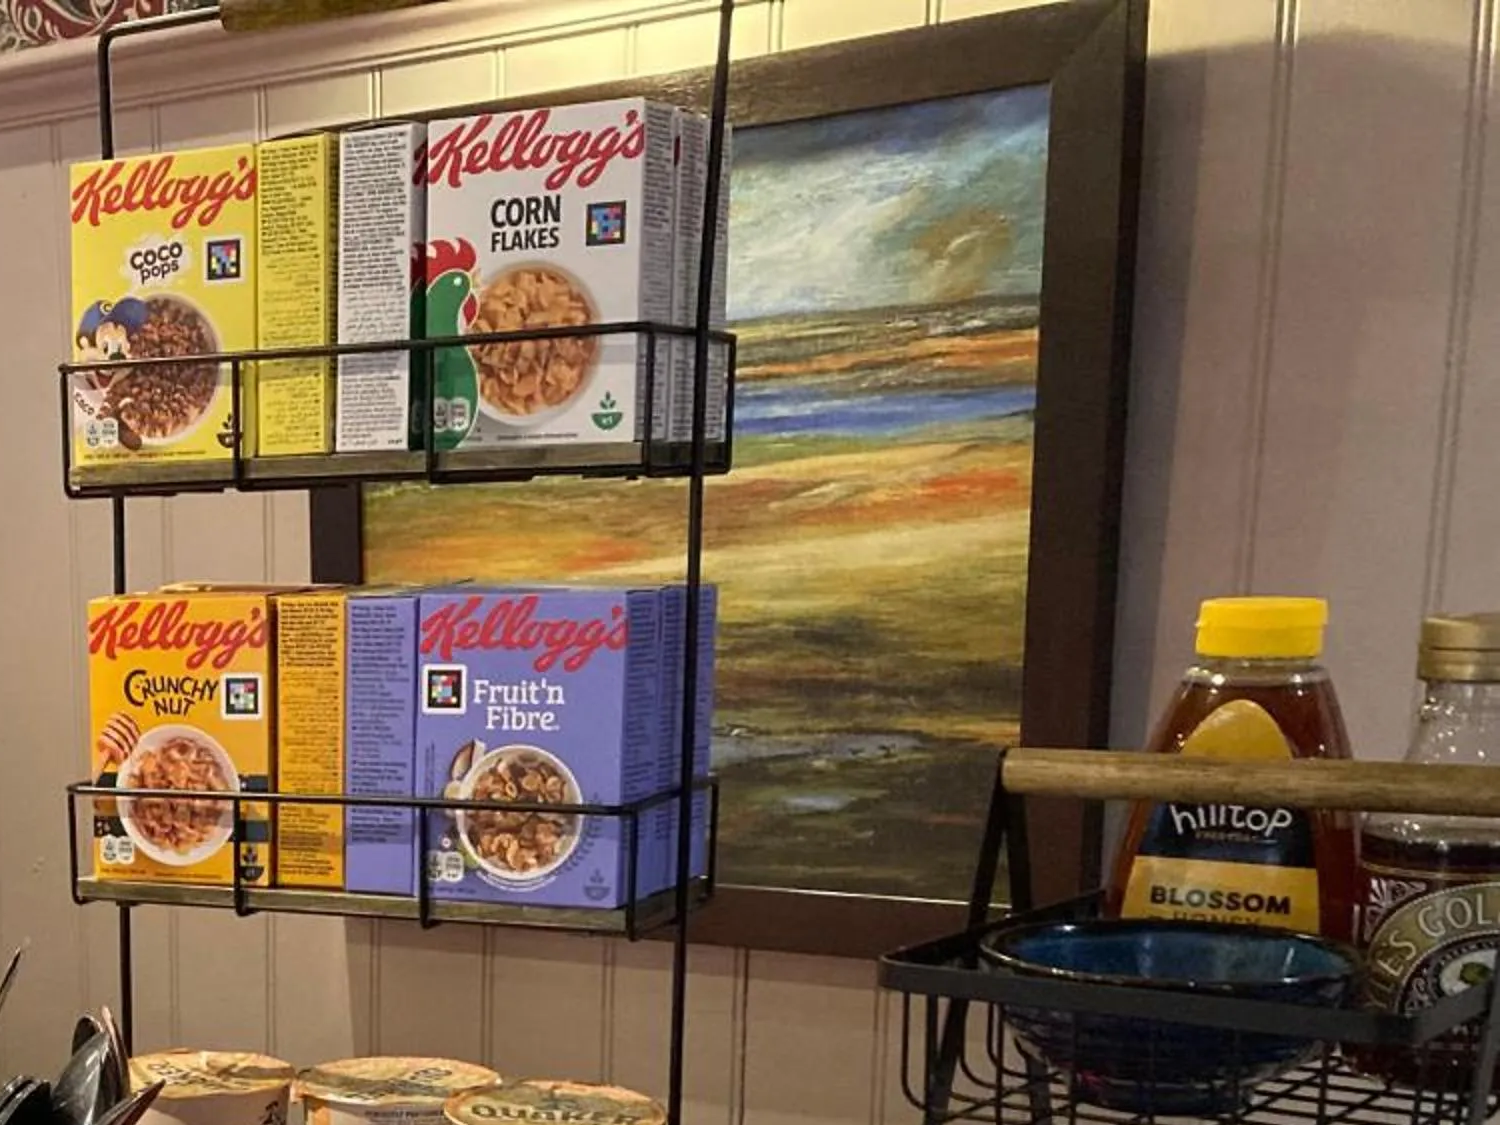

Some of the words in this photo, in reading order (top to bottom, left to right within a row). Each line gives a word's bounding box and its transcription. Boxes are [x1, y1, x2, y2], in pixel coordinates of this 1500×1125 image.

[414, 109, 645, 191] Kellogg's
[72, 156, 257, 229] Kellogg's
[490, 194, 562, 228] CORN
[490, 227, 561, 252] FLAKES
[141, 260, 179, 285] pops
[89, 600, 269, 670] Kellogg's
[420, 595, 630, 672] Kellogg's
[124, 669, 220, 707] CRUNCHY
[154, 698, 196, 716] NUT
[485, 706, 557, 731] Fibre
[1150, 885, 1291, 915] BLOSSOM
[1364, 928, 1417, 1010] YLE'S
[1417, 893, 1500, 938] GOL
